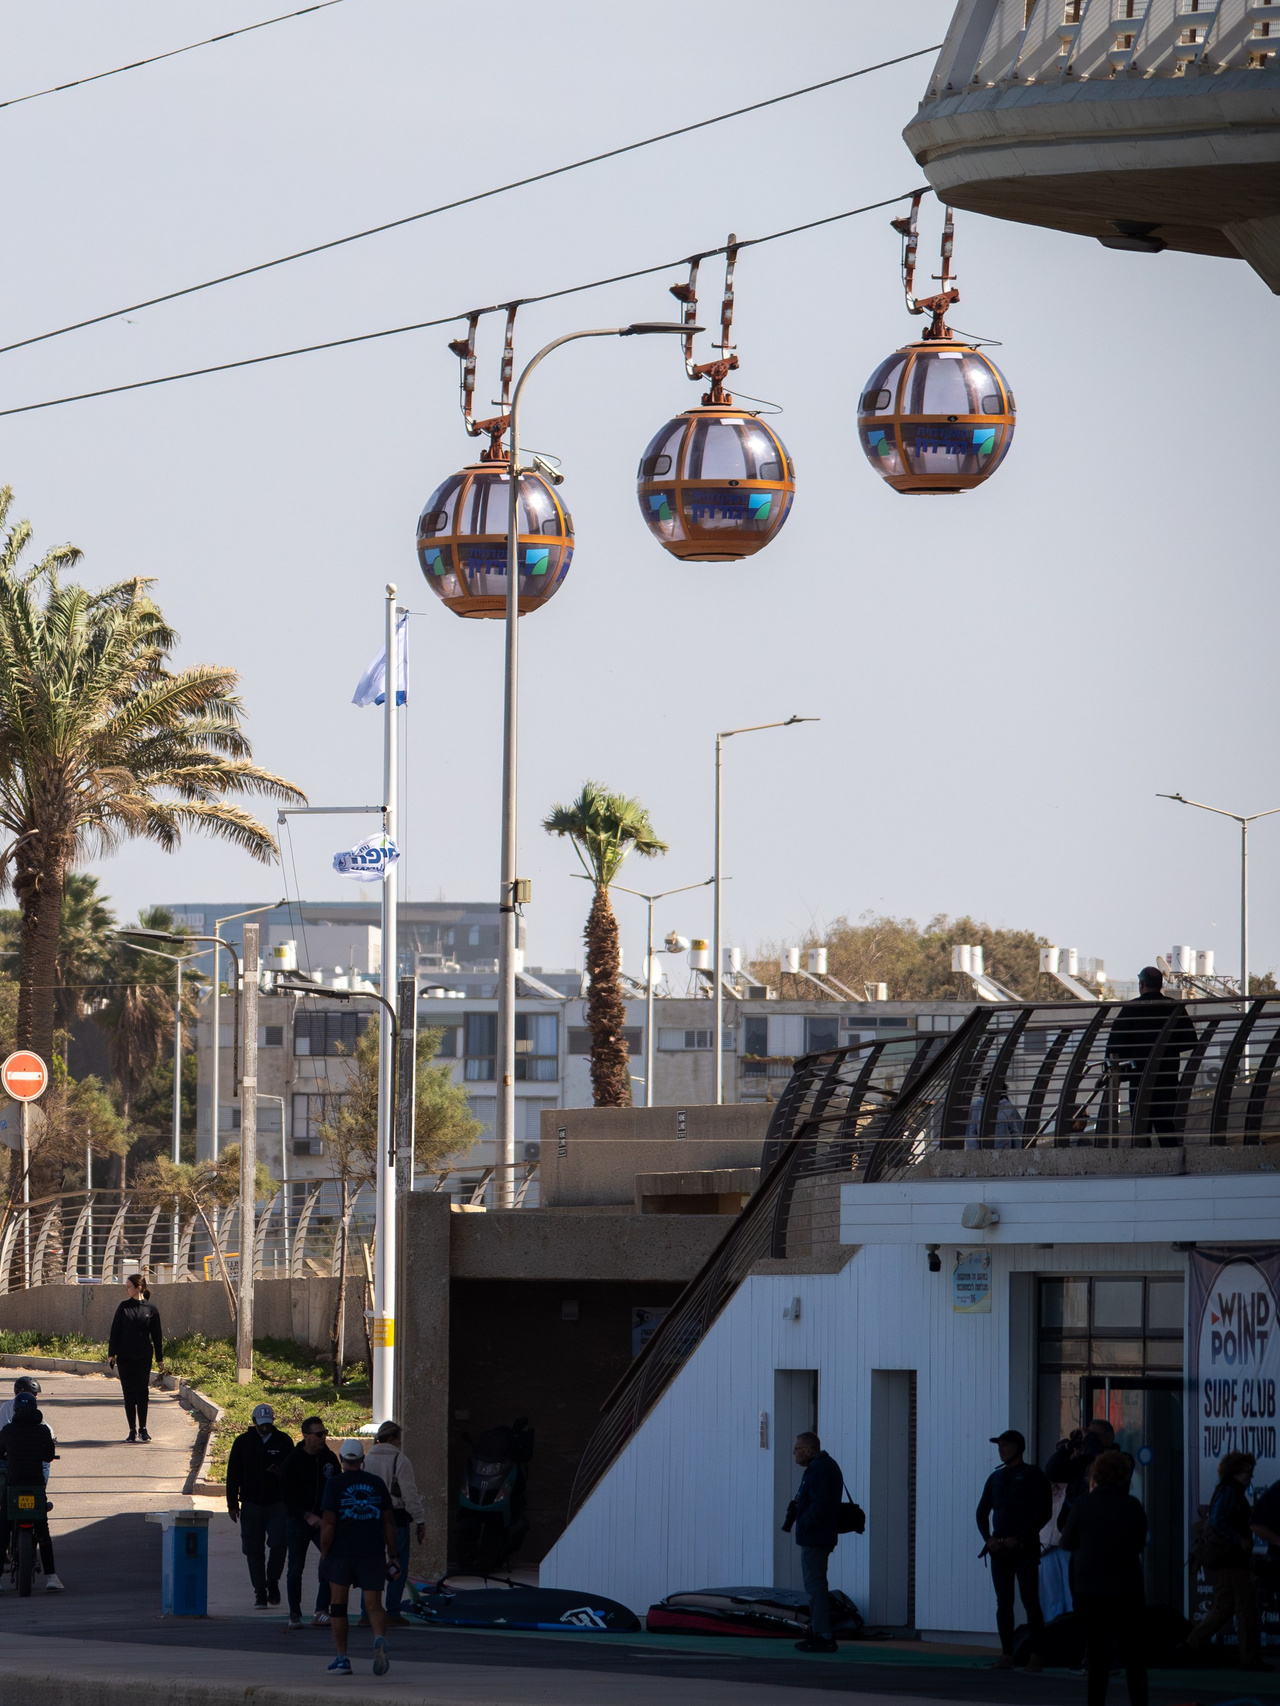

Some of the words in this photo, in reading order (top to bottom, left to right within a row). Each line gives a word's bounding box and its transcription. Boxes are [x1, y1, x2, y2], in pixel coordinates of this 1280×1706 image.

[1217, 1292, 1270, 1334] WIND
[1211, 1322, 1269, 1365] POINT
[1204, 1379, 1238, 1418] SURF
[1241, 1379, 1276, 1418] CLUB
[1204, 1421, 1237, 1458] גלישה
[1241, 1425, 1277, 1459] מועדון
